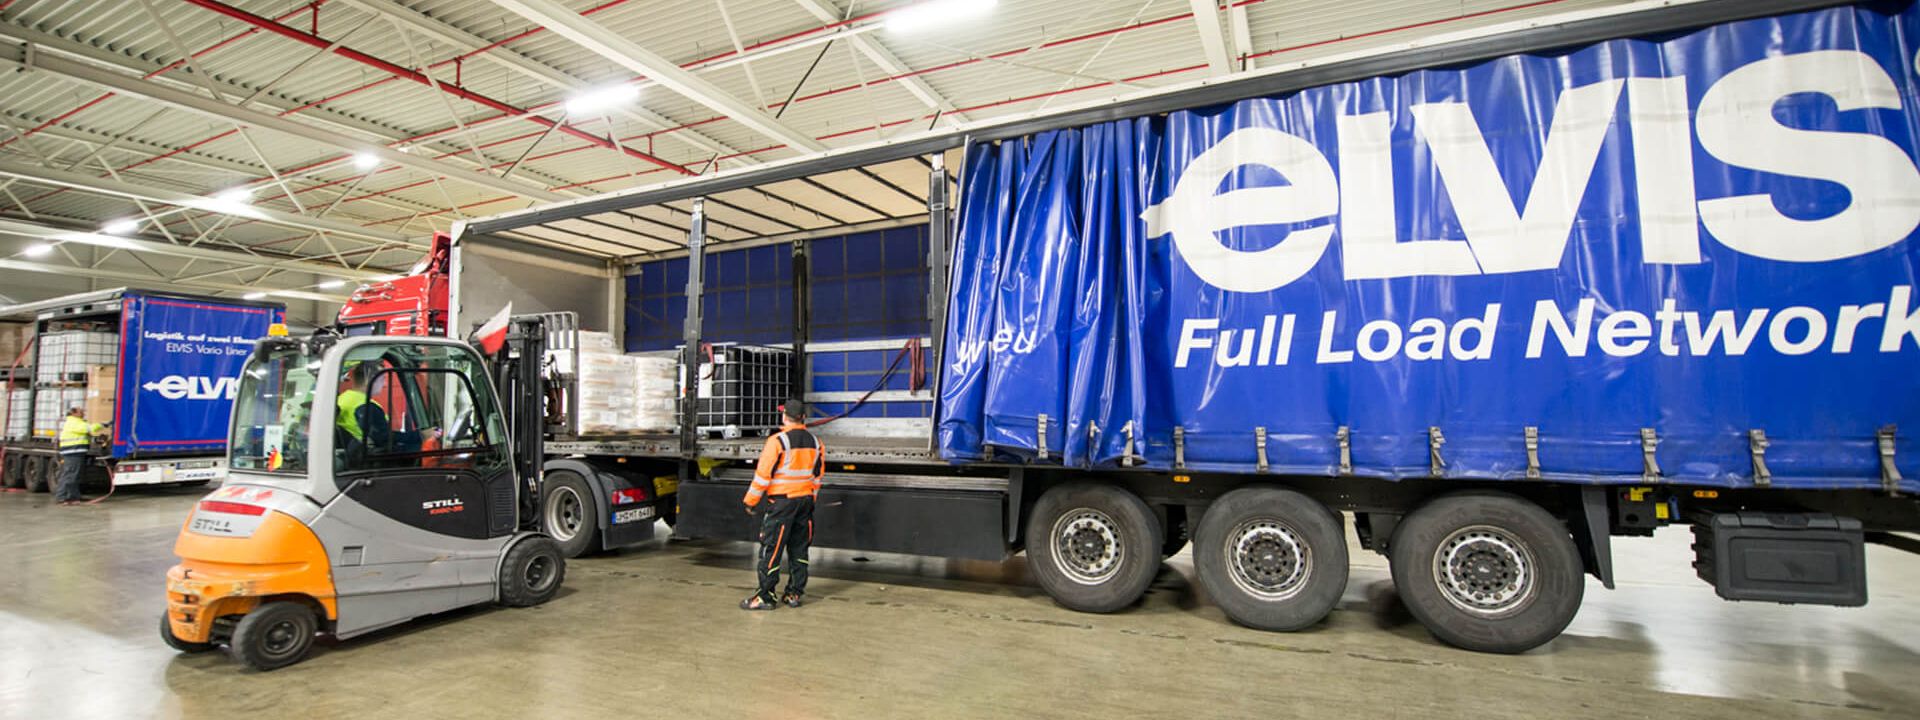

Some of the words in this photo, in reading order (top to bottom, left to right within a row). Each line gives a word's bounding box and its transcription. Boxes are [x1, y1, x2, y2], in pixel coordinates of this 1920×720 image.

[1174, 313, 1296, 368] Full
[1316, 303, 1502, 365] Load
[1526, 285, 1920, 360] Network
[144, 330, 185, 341] Logistik
[187, 333, 206, 342] auf
[166, 342, 193, 353] ELVIS
[196, 344, 223, 355] Vario
[225, 346, 248, 356] Liner
[142, 375, 240, 400] eLVI
[422, 498, 464, 509] STILL
